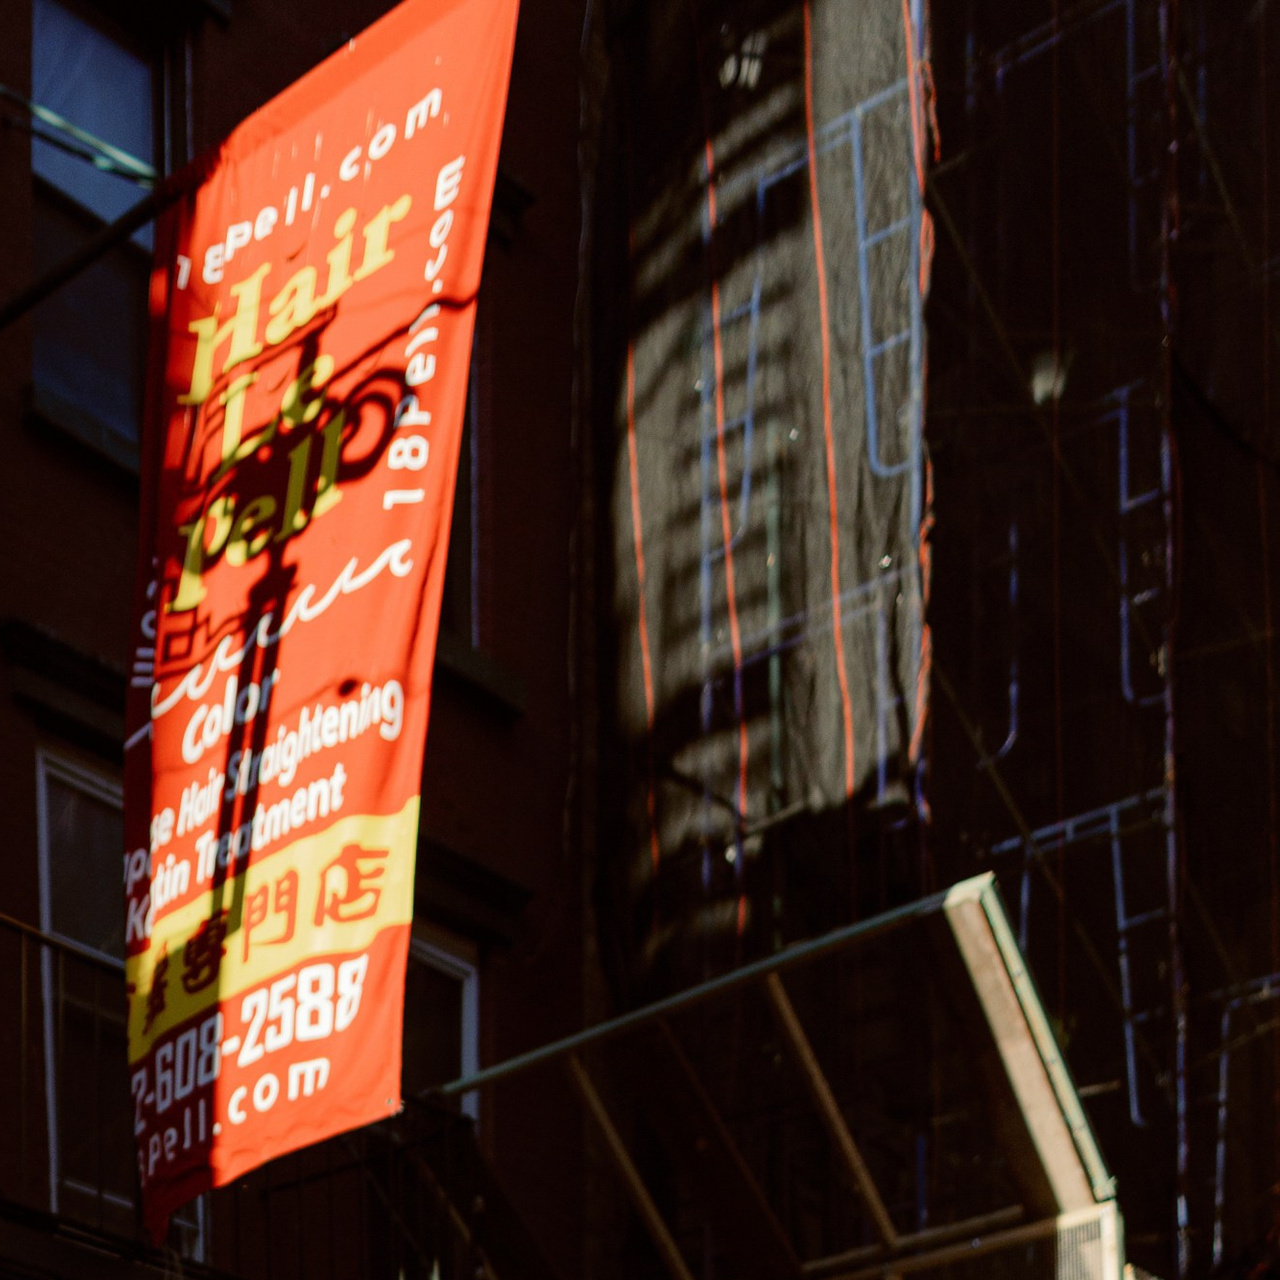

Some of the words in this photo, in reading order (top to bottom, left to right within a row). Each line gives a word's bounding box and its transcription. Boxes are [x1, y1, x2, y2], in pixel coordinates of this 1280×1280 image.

[177, 194, 413, 405] Hair
[176, 767, 226, 838] Hair
[224, 679, 405, 801] Straightening
[182, 667, 281, 765] Color
[195, 762, 347, 885] Treatment
